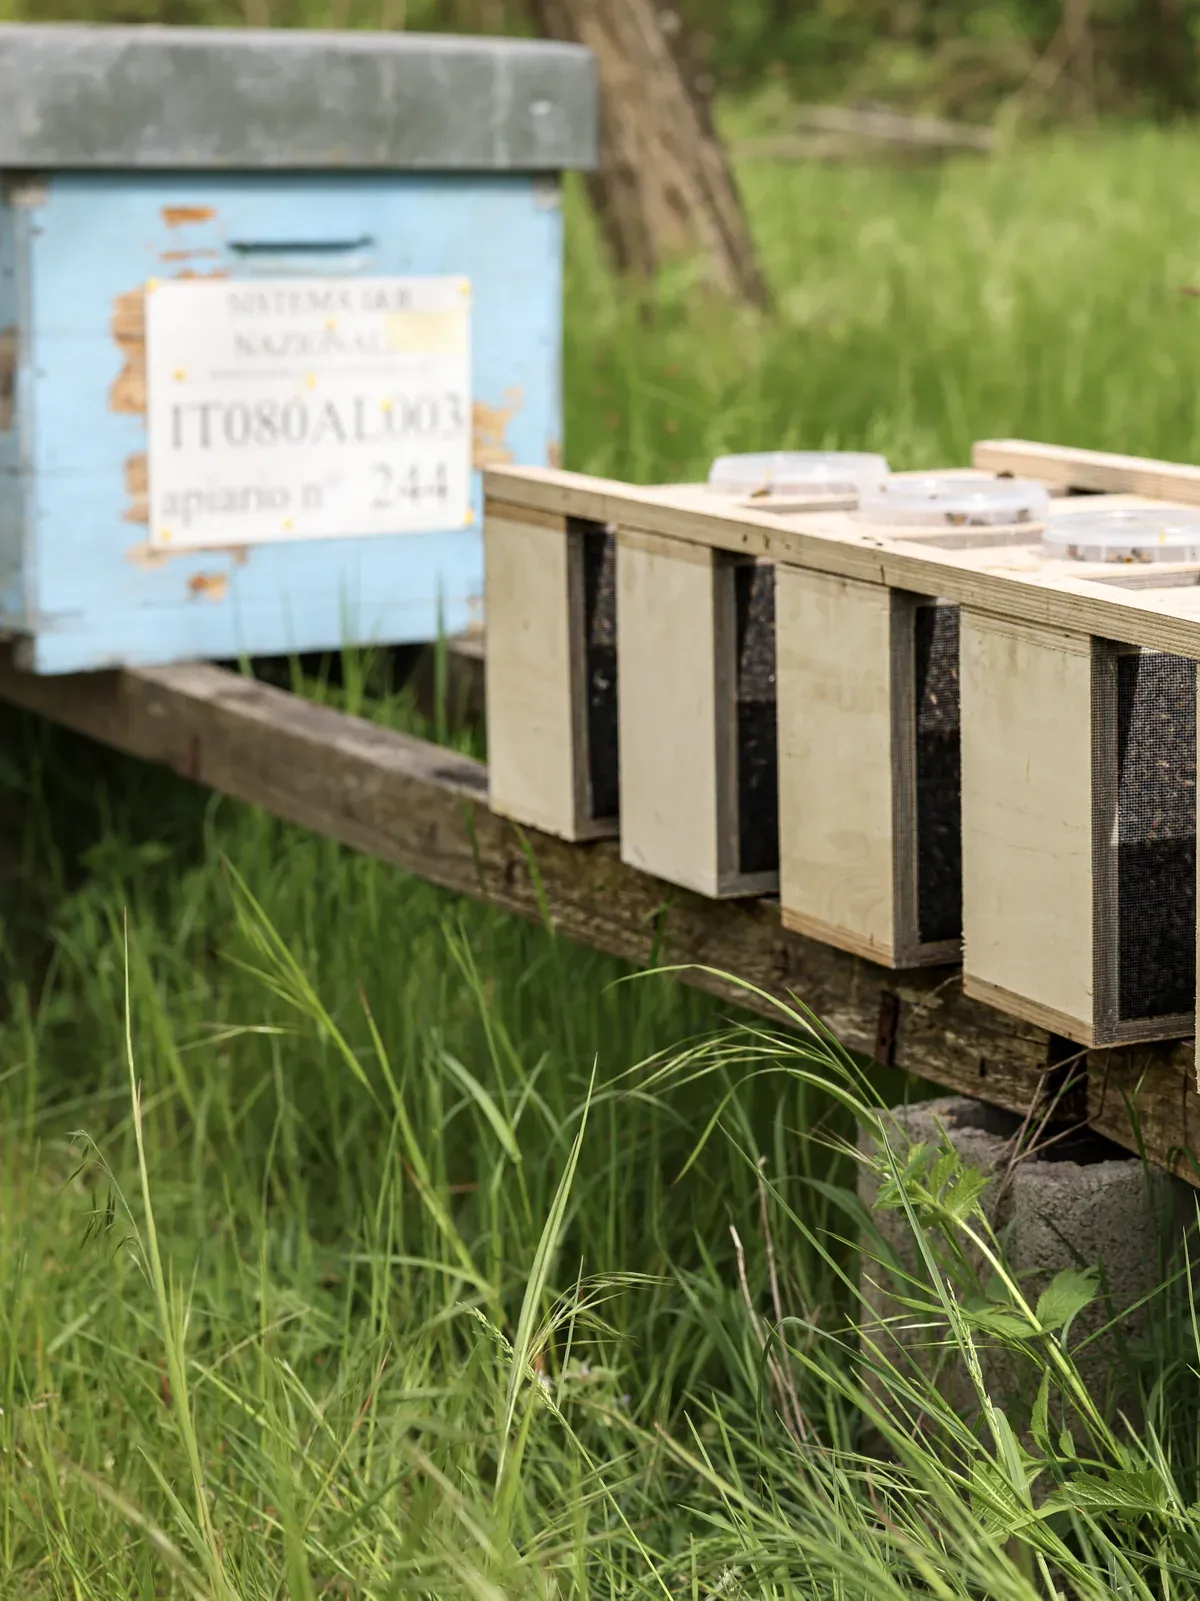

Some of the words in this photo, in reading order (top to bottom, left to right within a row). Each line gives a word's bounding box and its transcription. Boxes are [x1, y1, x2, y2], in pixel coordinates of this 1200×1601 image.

[234, 329, 402, 357] NAZIONAL
[161, 472, 292, 527] apiario
[369, 459, 450, 510] 244
